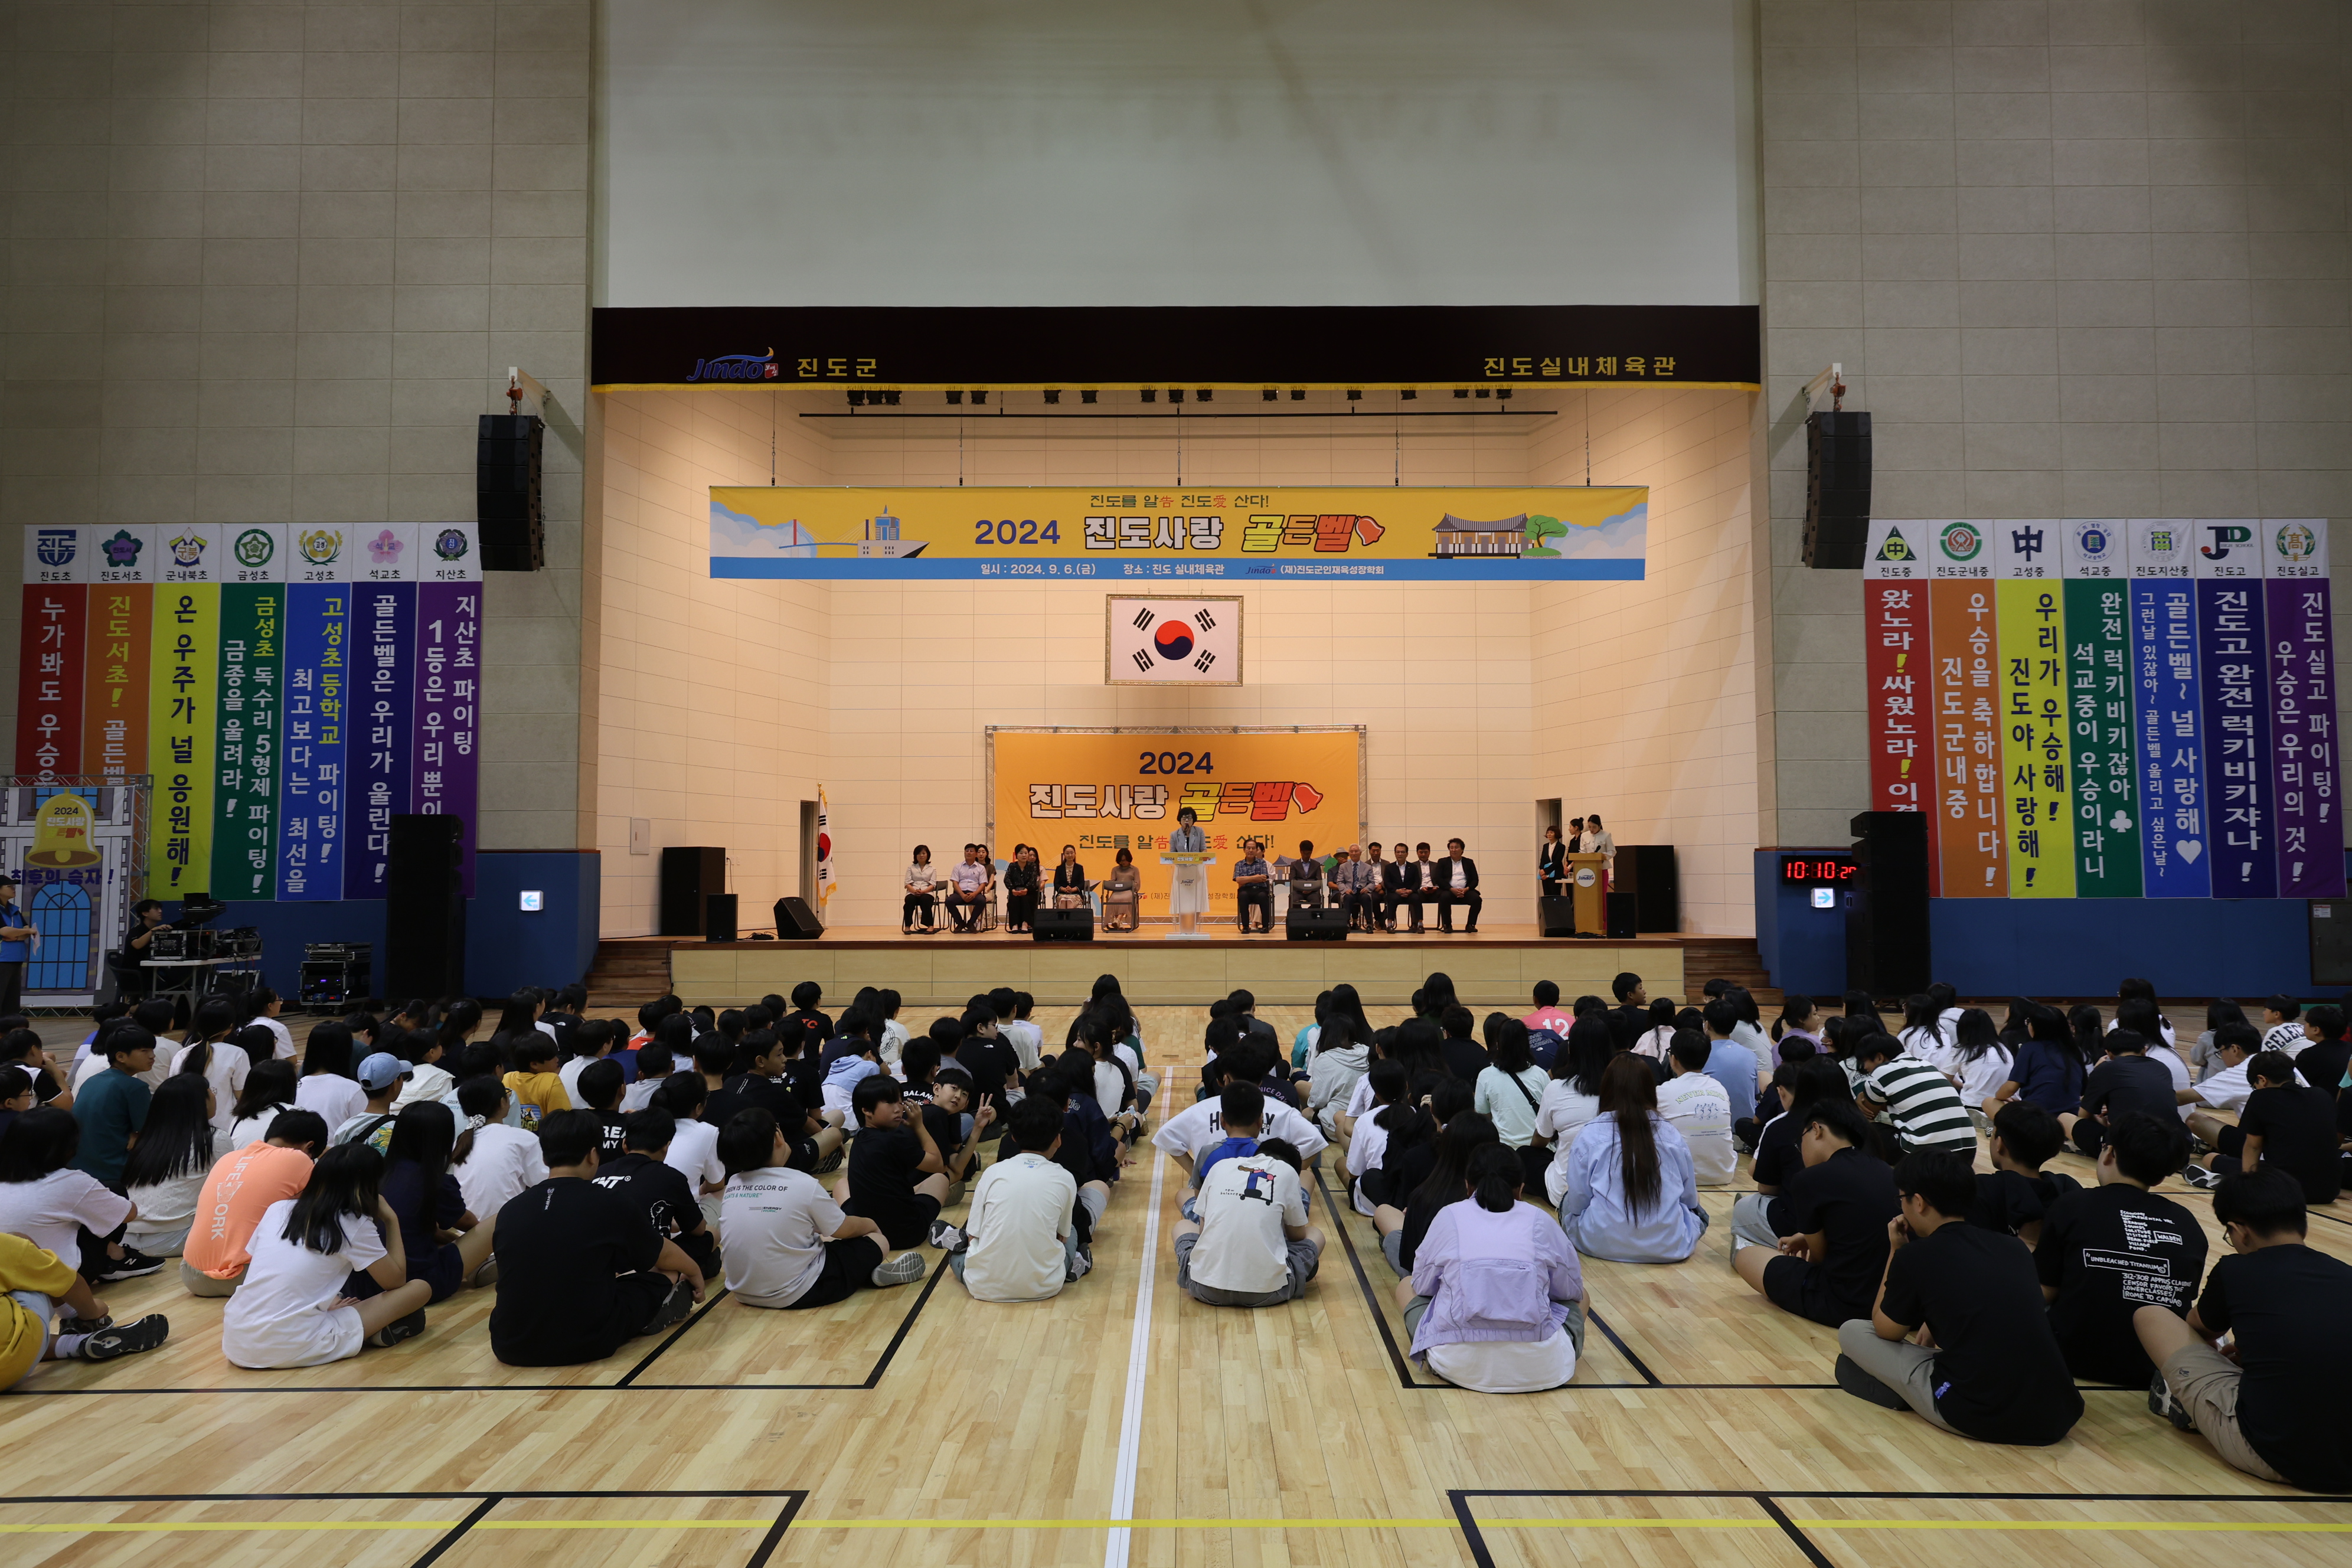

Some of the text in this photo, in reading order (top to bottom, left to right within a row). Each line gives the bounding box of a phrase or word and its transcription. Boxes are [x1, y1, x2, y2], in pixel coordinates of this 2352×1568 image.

[686, 356, 764, 381] Jindo
[797, 358, 877, 377] 진도군
[1484, 356, 1676, 377] 진도실내체육관
[1090, 495, 1137, 508] 진도를
[1234, 495, 1269, 508] 산다!
[975, 514, 1357, 553] 2024 진도사랑 골든벨
[40, 571, 71, 582] 진도초
[100, 570, 142, 582] 진도서초
[166, 570, 208, 582] 군내북초
[237, 570, 269, 581] 금성초
[304, 570, 335, 582] 고성초
[369, 570, 401, 580] 석교초
[436, 570, 467, 580] 지산초
[981, 563, 1001, 576] 일시
[1123, 564, 1144, 575] 장소
[1152, 564, 1172, 575] 진도
[1175, 564, 1225, 576] 실내체육관
[1881, 567, 1912, 578] 진도중
[1936, 567, 1989, 577] 진도군내중
[2013, 567, 2045, 577] 고성중
[2079, 566, 2112, 576] 석교중
[2136, 566, 2189, 577] 진도지산중
[2214, 566, 2246, 577] 진도고
[2276, 566, 2320, 576] 진도실고
[2139, 593, 2157, 640] 그런날
[2214, 591, 2252, 654] 진도고
[371, 594, 397, 692] 골든벨은
[423, 619, 446, 702] 1등은
[223, 640, 247, 711] 금종을
[453, 595, 476, 755] 지산초 파이팅
[2217, 664, 2255, 708] 완전
[2275, 641, 2301, 724] 우승은
[34, 597, 66, 786] 누가봐도 우승은
[102, 596, 131, 786] 진도서초! 골든벨
[2101, 592, 2131, 801] 완전 럭키비키잖아
[2036, 593, 2064, 822] 우리가 우승해!
[2302, 592, 2331, 824] 진도실고 파이팅!
[318, 598, 344, 863] 고성초등학교 파이팅!
[370, 700, 394, 773] 우리가
[2145, 710, 2161, 758] 골든벨
[2171, 710, 2194, 737] 널
[166, 595, 197, 887] 온 우주가 널 응원해!
[248, 597, 276, 894] 금성초 독수리 5형제 파이팅!
[1941, 657, 1968, 819] 진도군내중
[1967, 593, 2001, 887] 우승을 축하합니다!
[1139, 752, 1214, 775] 2024
[2010, 658, 2039, 888] 진도야 사랑해!
[2073, 643, 2105, 878] 석교중이 우승이라니
[285, 668, 313, 893] 최고보다는 최선을
[2147, 763, 2164, 809] 울리고
[2278, 733, 2304, 816] 우리의
[1029, 780, 1294, 821] 진도사랑 골든벨
[47, 817, 85, 827] 진도사랑
[1080, 834, 1130, 850] 진도를
[11, 869, 102, 886] 최후의 승자
[1675, 1090, 1705, 1105] NEVER
[226, 1156, 254, 1181] LIFE
[2157, 1234, 2181, 1242] WALDEN
[2122, 1273, 2171, 1285] 312-308 APPIUS
